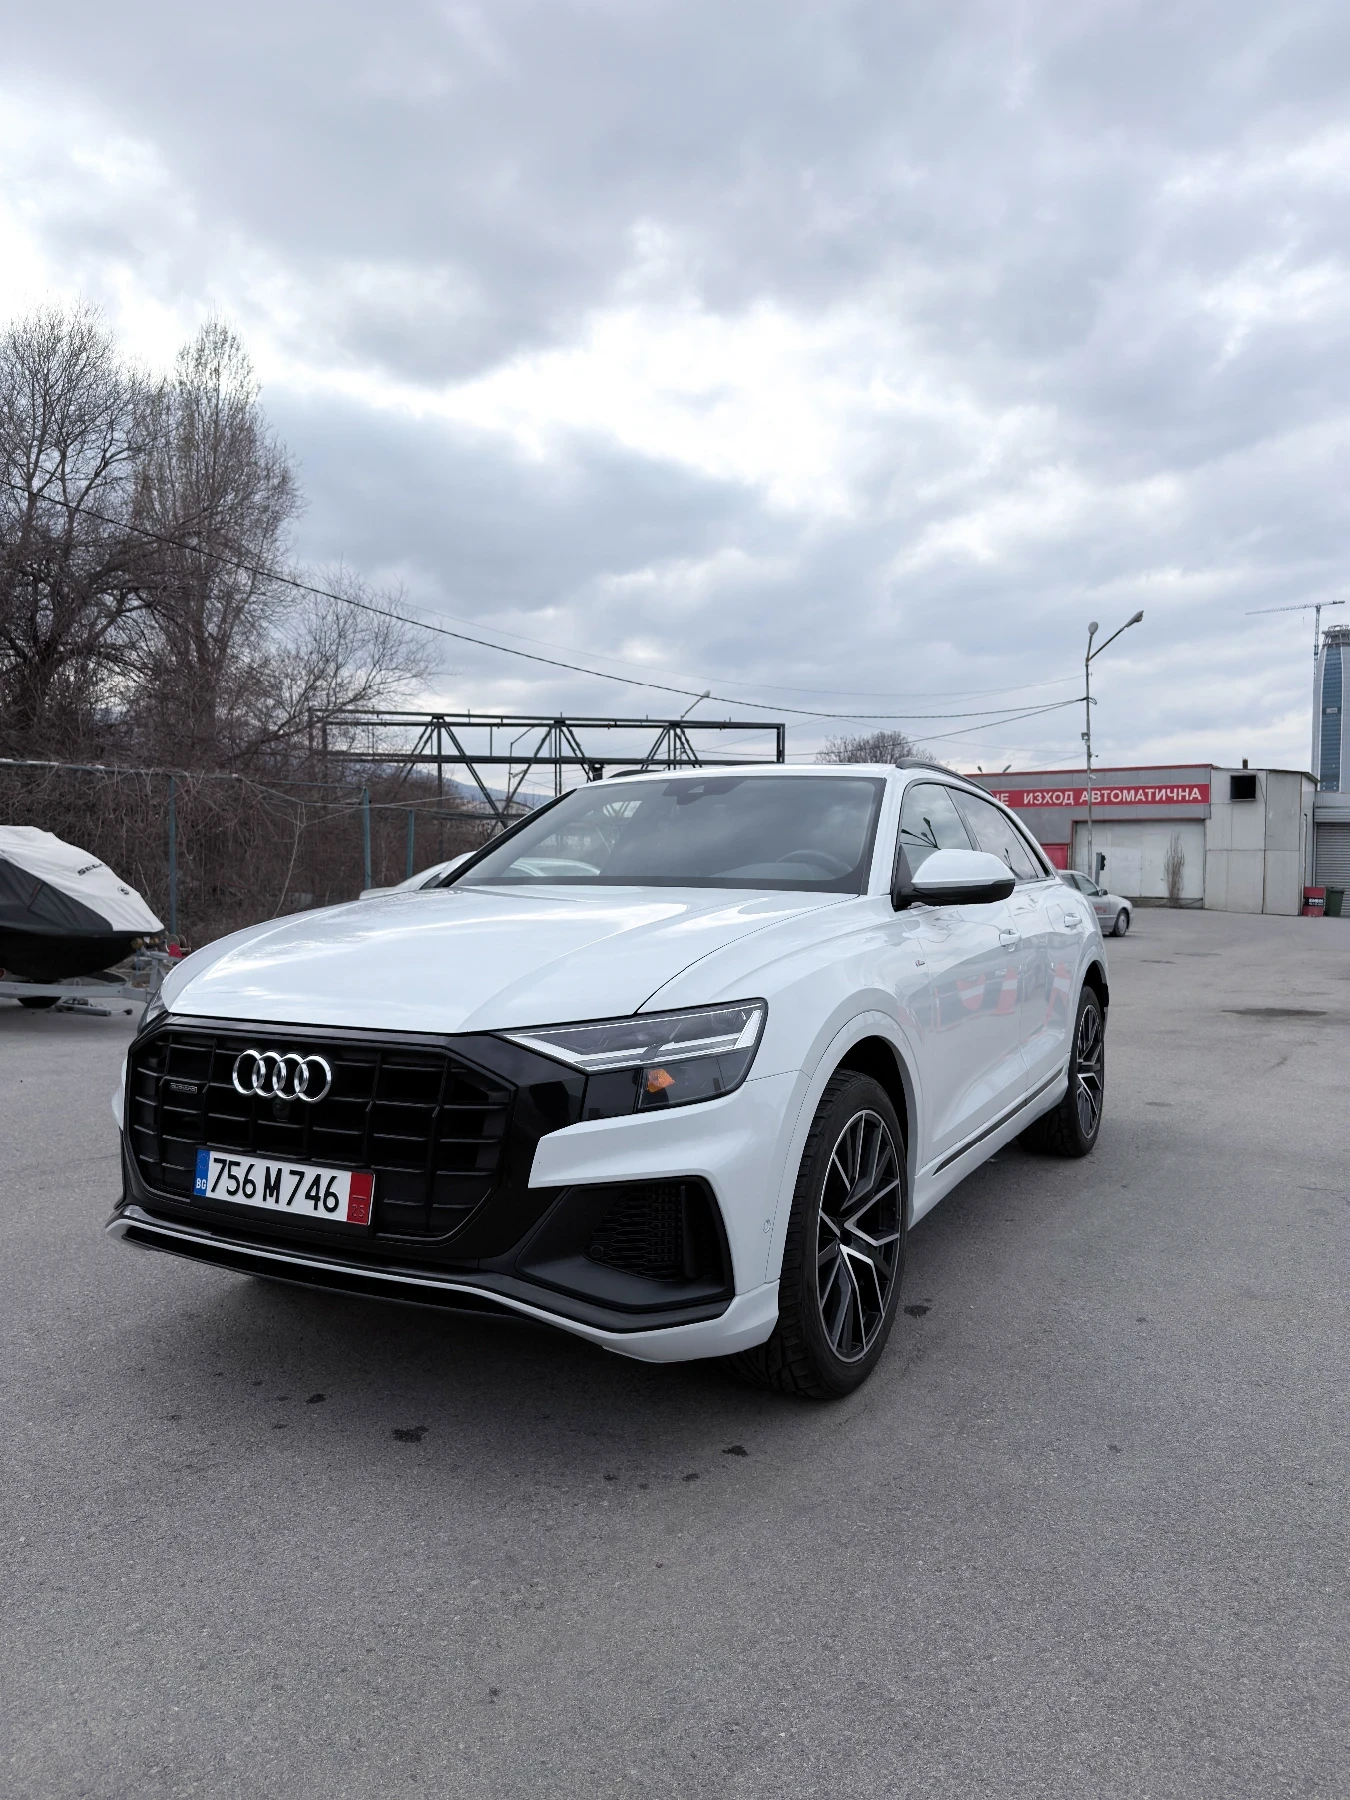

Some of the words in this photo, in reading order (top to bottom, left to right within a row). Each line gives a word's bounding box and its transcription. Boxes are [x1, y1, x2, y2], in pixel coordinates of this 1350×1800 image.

[1023, 791, 1074, 805] ИЗХОД
[1079, 787, 1202, 803] АВТОМАТИЧНА
[196, 1178, 206, 1189] BG
